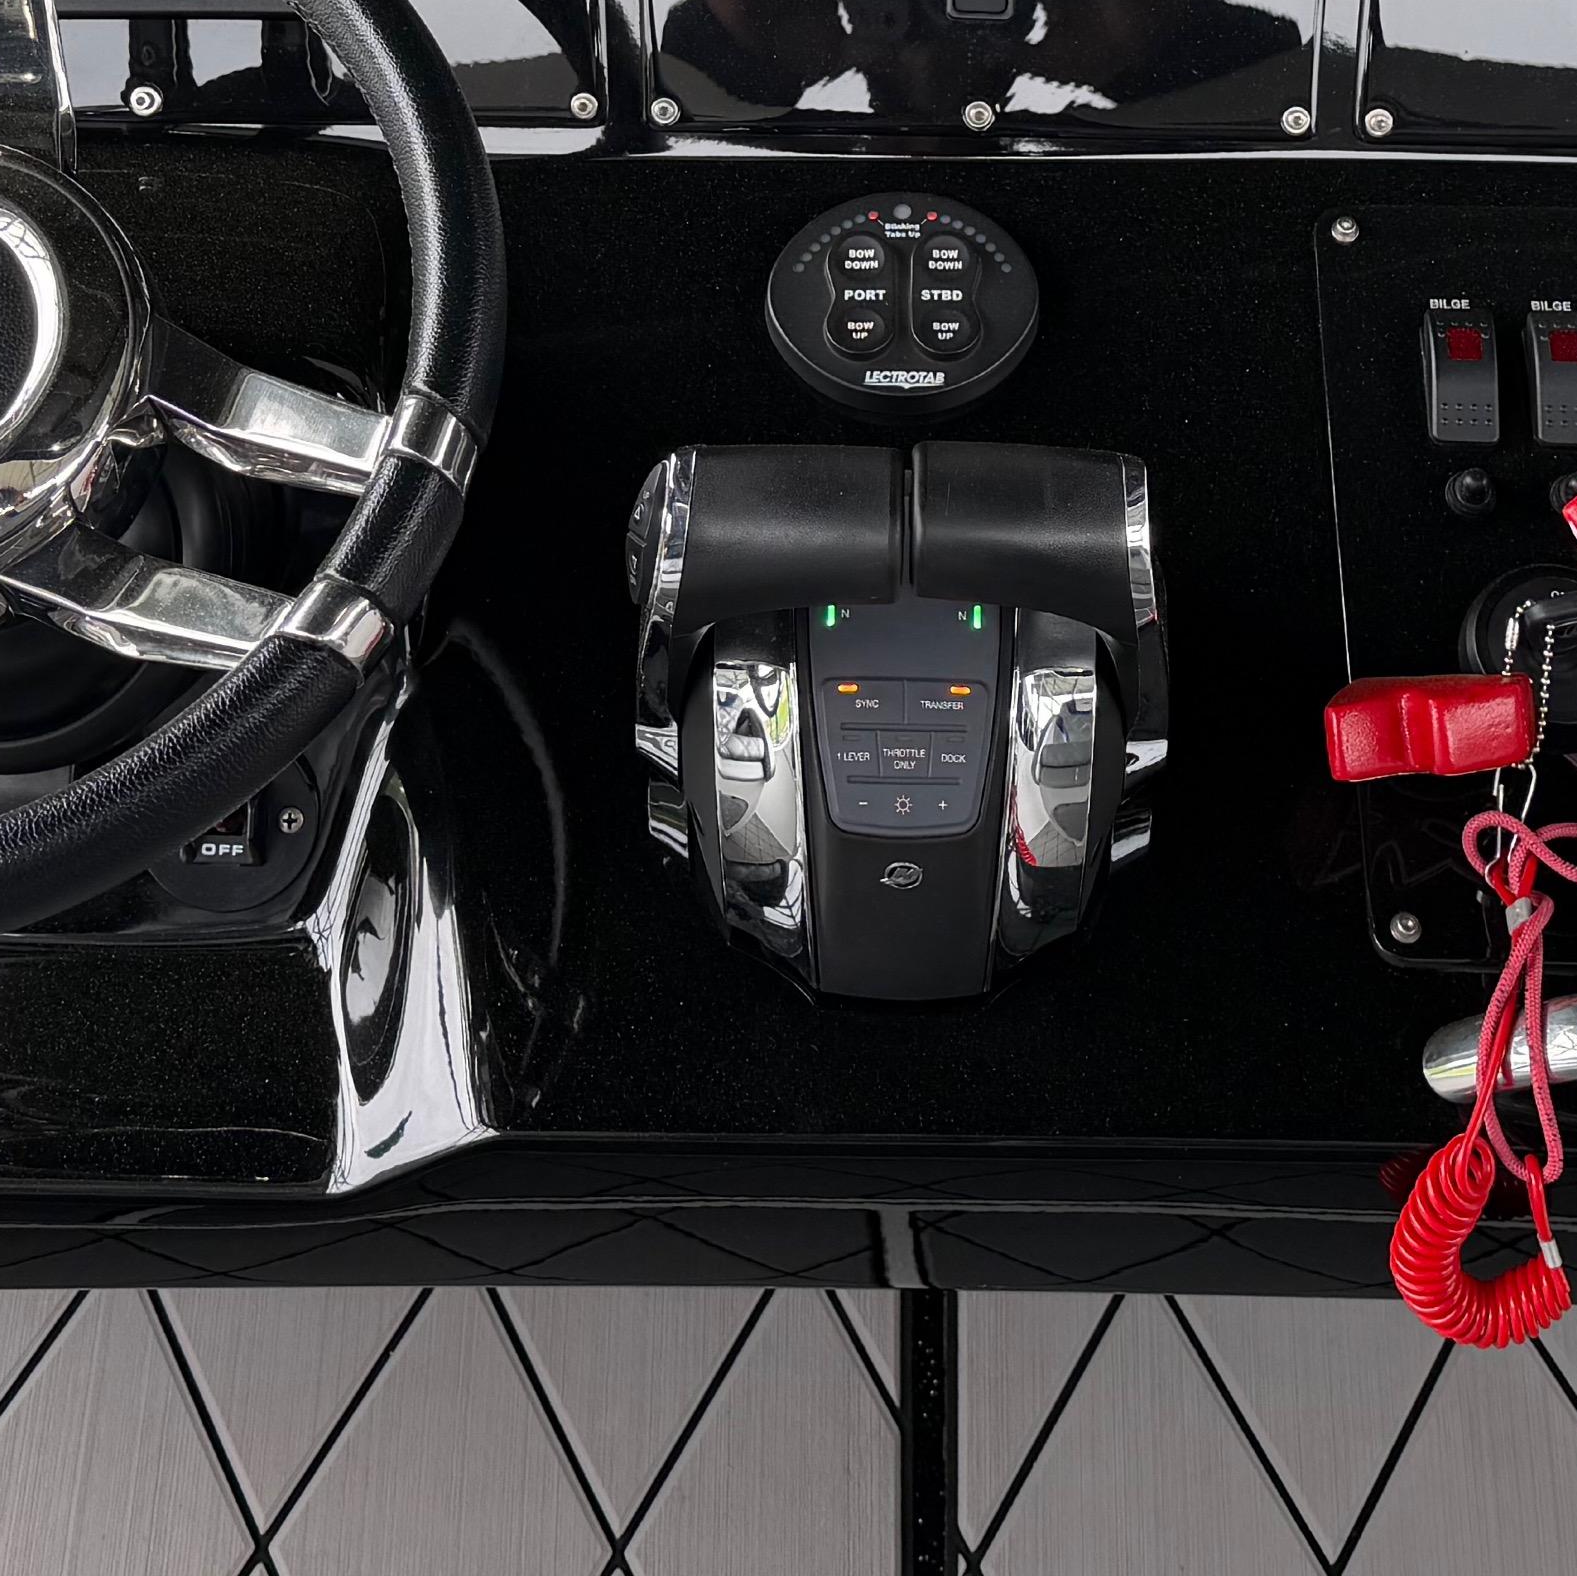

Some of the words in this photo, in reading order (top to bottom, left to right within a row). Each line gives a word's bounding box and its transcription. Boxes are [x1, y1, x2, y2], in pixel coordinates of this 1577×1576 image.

[848, 248, 875, 259] BOW
[932, 248, 959, 260] BOW
[844, 260, 879, 270] DOWN
[928, 260, 963, 270] DOWN
[844, 289, 886, 302] PORT
[921, 289, 963, 302] STBD
[1430, 299, 1470, 309] BILGE
[1531, 301, 1571, 311] BILGE
[847, 321, 874, 331] BOW
[932, 321, 960, 331] BOW
[852, 331, 868, 340] UP
[937, 332, 954, 340] UP
[864, 370, 946, 385] LECTROTAB
[841, 609, 850, 618] N
[958, 611, 967, 621] N
[855, 699, 879, 709] SYNC
[920, 700, 964, 710] TRANSFER
[843, 752, 870, 761] LEVER
[883, 748, 926, 758] THROTTLE
[941, 753, 966, 763] DOCK
[894, 760, 916, 770] ONLY
[202, 844, 243, 855] OFF
